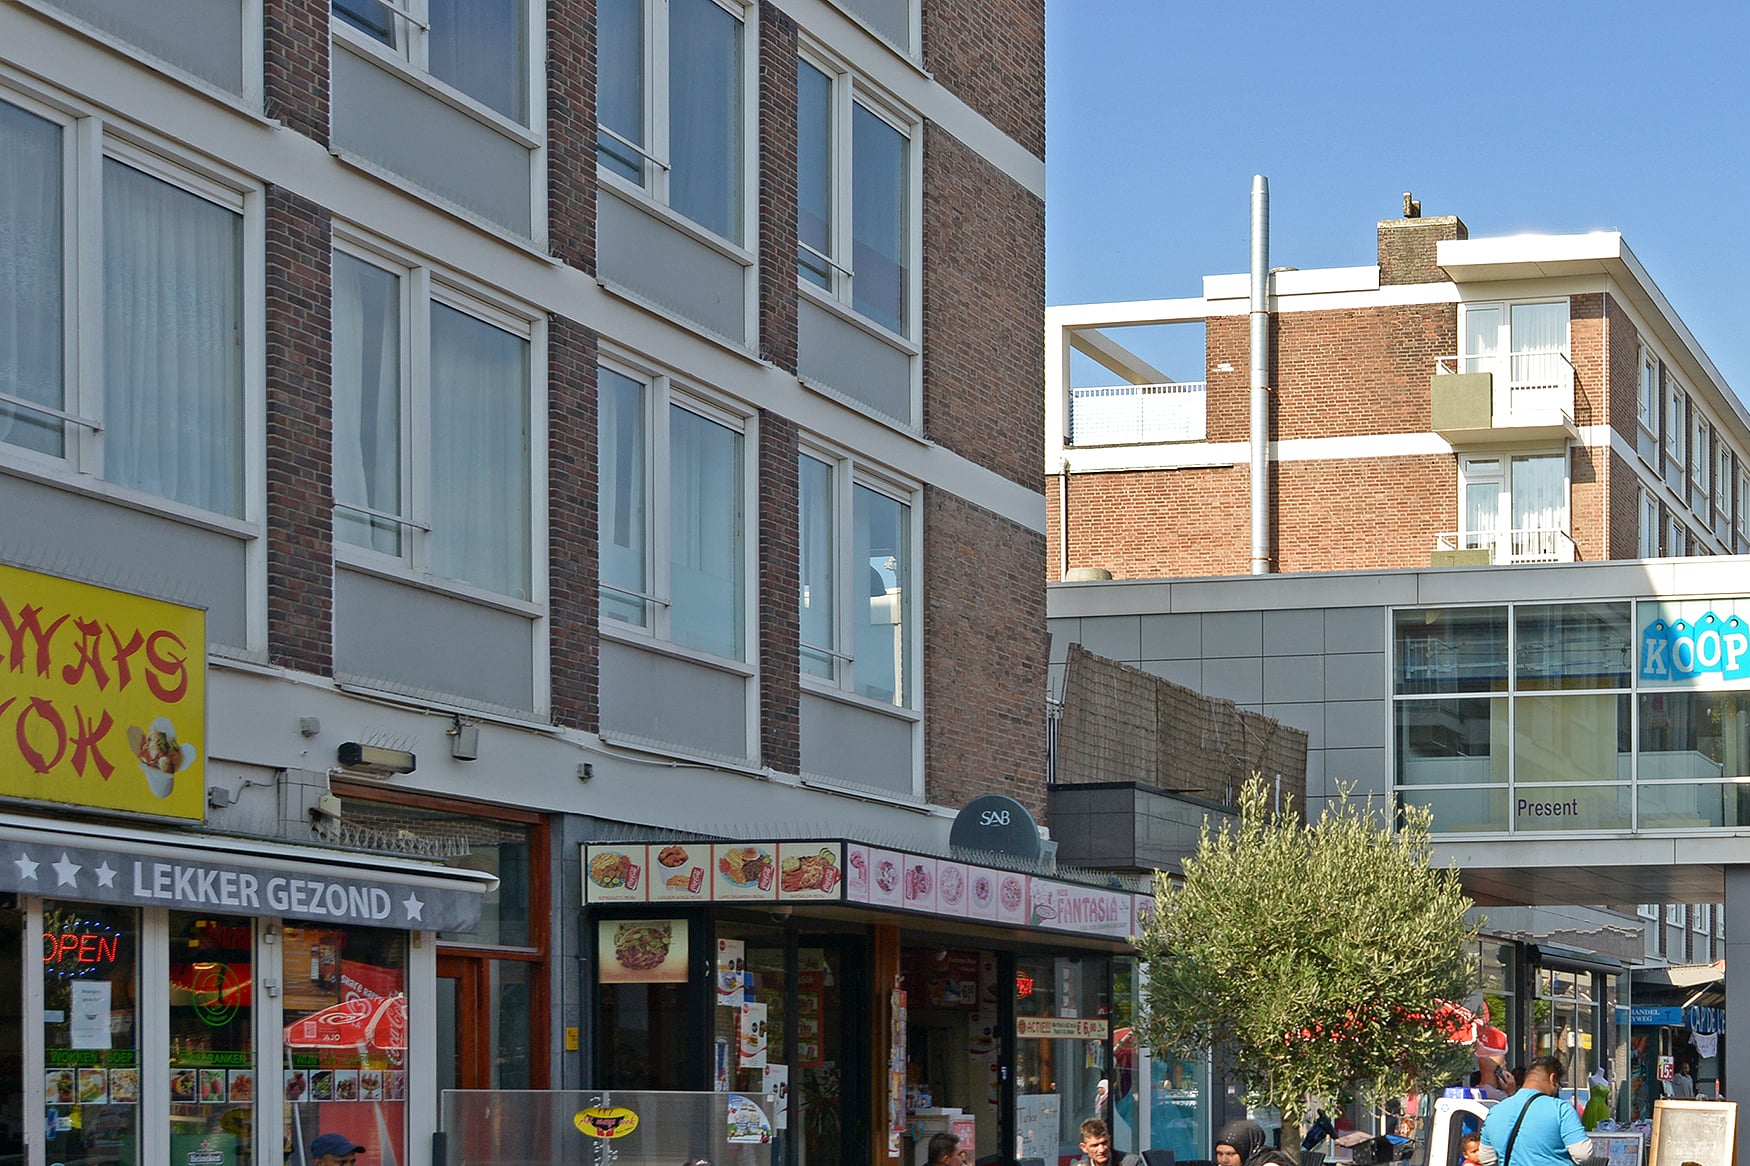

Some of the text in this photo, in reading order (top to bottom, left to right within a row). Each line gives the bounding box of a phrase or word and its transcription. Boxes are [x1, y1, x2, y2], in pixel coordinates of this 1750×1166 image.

[0, 596, 188, 704] WAYS
[1643, 630, 1749, 675] KOOP
[979, 810, 1010, 826] SAB
[1517, 798, 1578, 816] Present
[133, 861, 392, 921] LEKKER GEZOND
[1057, 897, 1118, 923] FANTASIA
[42, 933, 118, 963] OPEN
